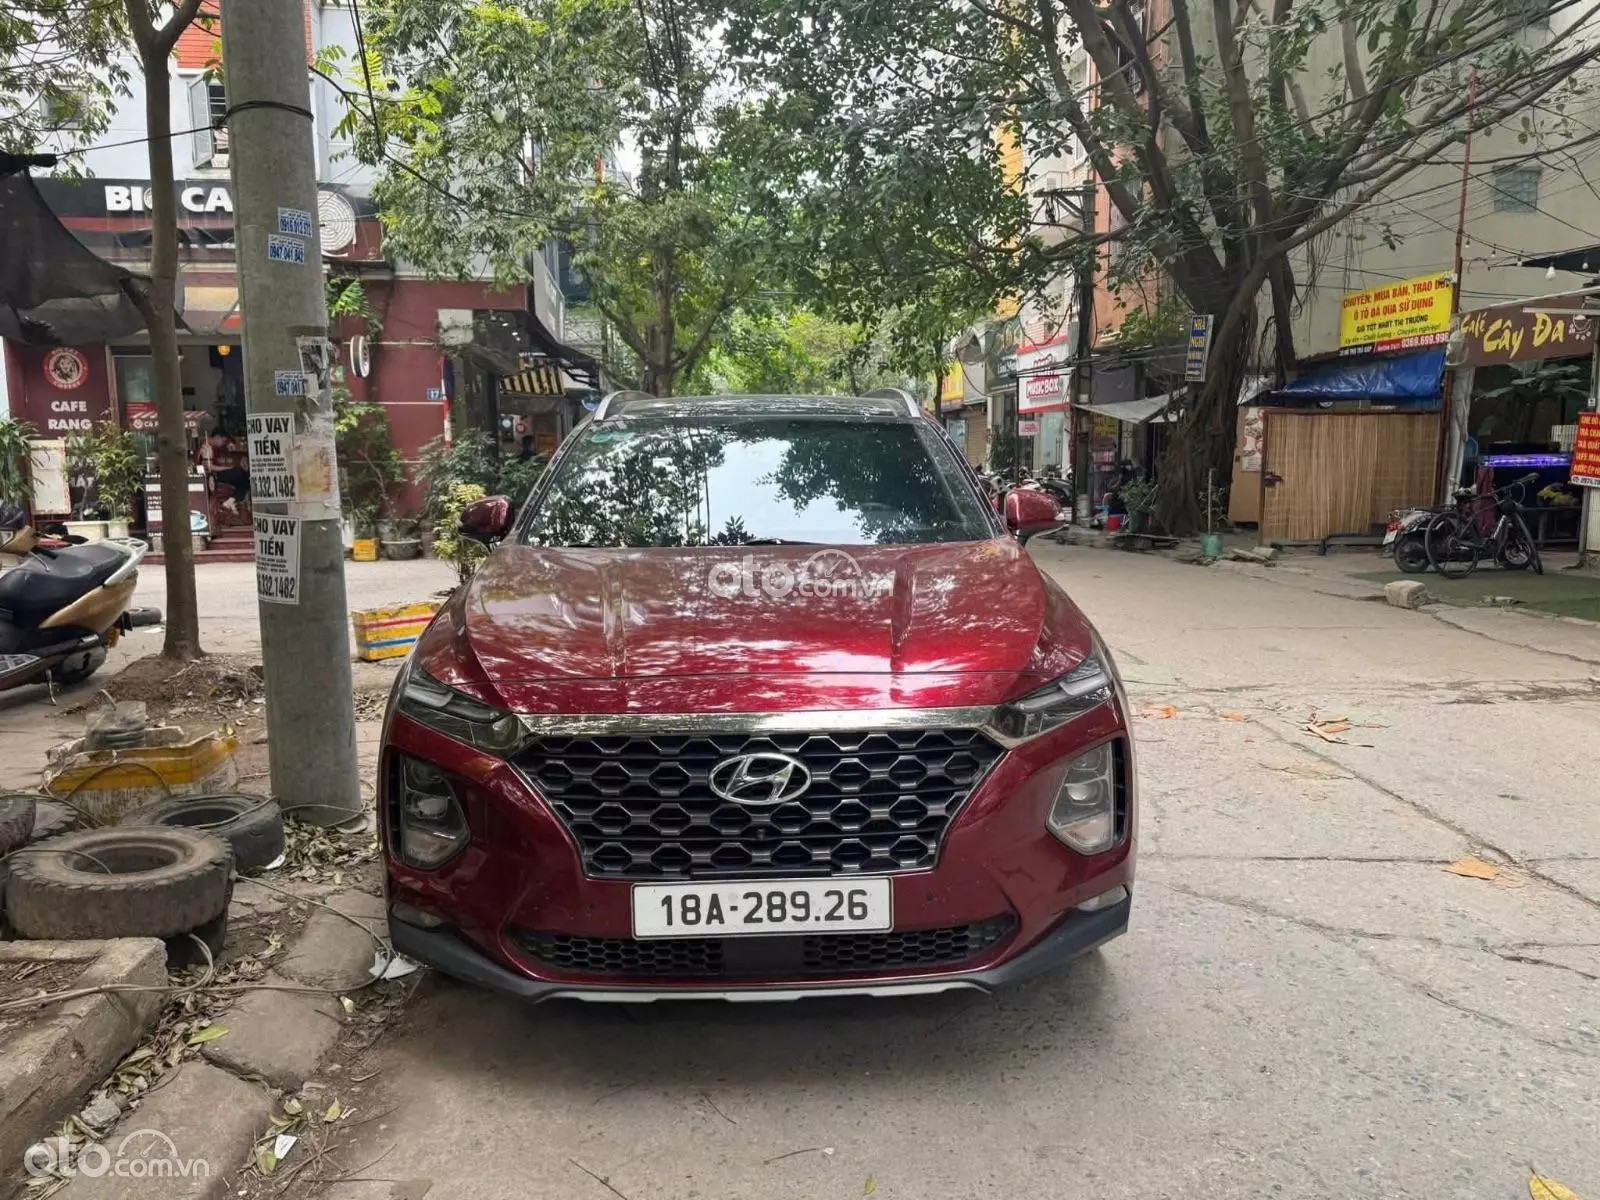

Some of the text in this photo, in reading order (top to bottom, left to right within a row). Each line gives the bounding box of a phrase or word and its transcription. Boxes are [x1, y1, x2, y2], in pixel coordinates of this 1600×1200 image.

[181, 186, 233, 213] CA
[51, 400, 87, 413] CAFE
[48, 418, 93, 431] RANG
[265, 417, 289, 434] VAY
[272, 518, 297, 536] VAY
[661, 889, 868, 926] 18A-289.26
